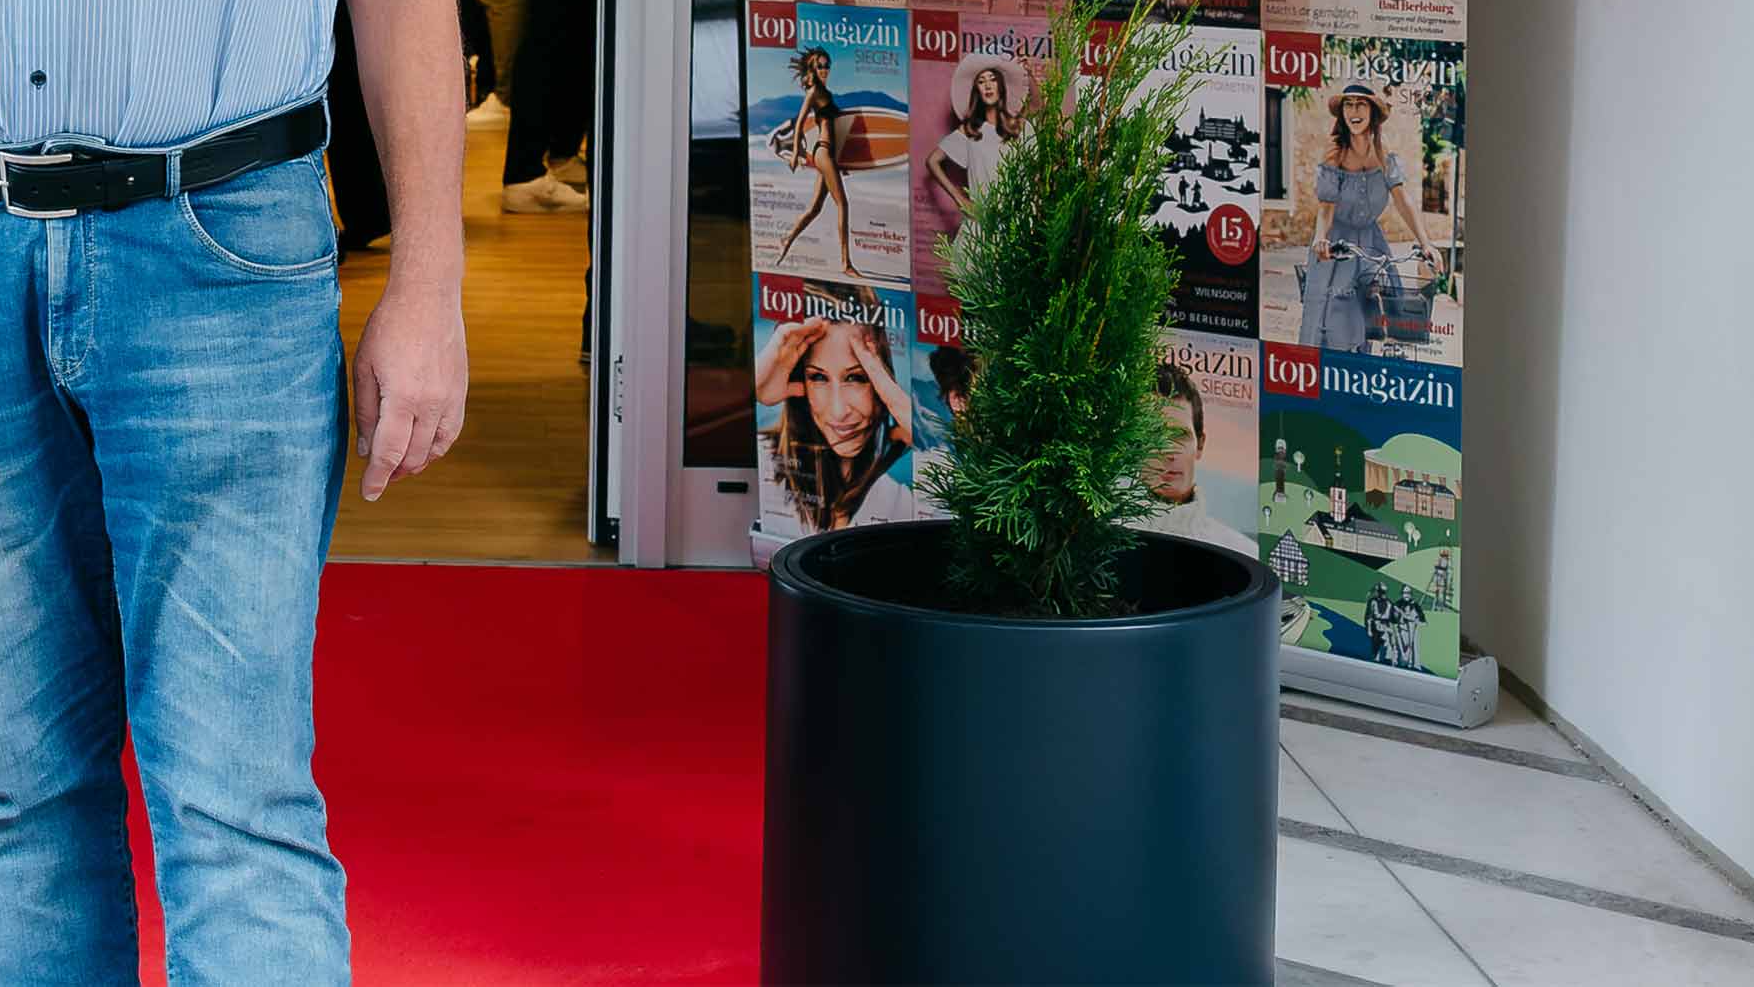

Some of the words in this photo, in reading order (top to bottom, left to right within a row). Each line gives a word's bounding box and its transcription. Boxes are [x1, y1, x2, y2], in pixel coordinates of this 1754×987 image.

[1379, 0, 1399, 11] Bad
[1401, 0, 1454, 15] Berleburg
[753, 13, 795, 44] top
[796, 18, 900, 47] magazin
[916, 24, 957, 57] top
[962, 28, 1060, 61] magazi
[1083, 40, 1116, 68] to
[1152, 44, 1255, 77] agazin
[1269, 46, 1319, 83] top
[1221, 216, 1243, 240] 15
[762, 285, 803, 317] top
[805, 294, 905, 328] magazin
[1194, 285, 1247, 302] WILNSDORF
[919, 308, 959, 342] top
[1189, 312, 1249, 330] BERLEBURG
[1157, 342, 1252, 379] agazin
[1201, 378, 1252, 400] SIEGEN
[1269, 353, 1317, 392] top
[1323, 364, 1455, 409] magazin
